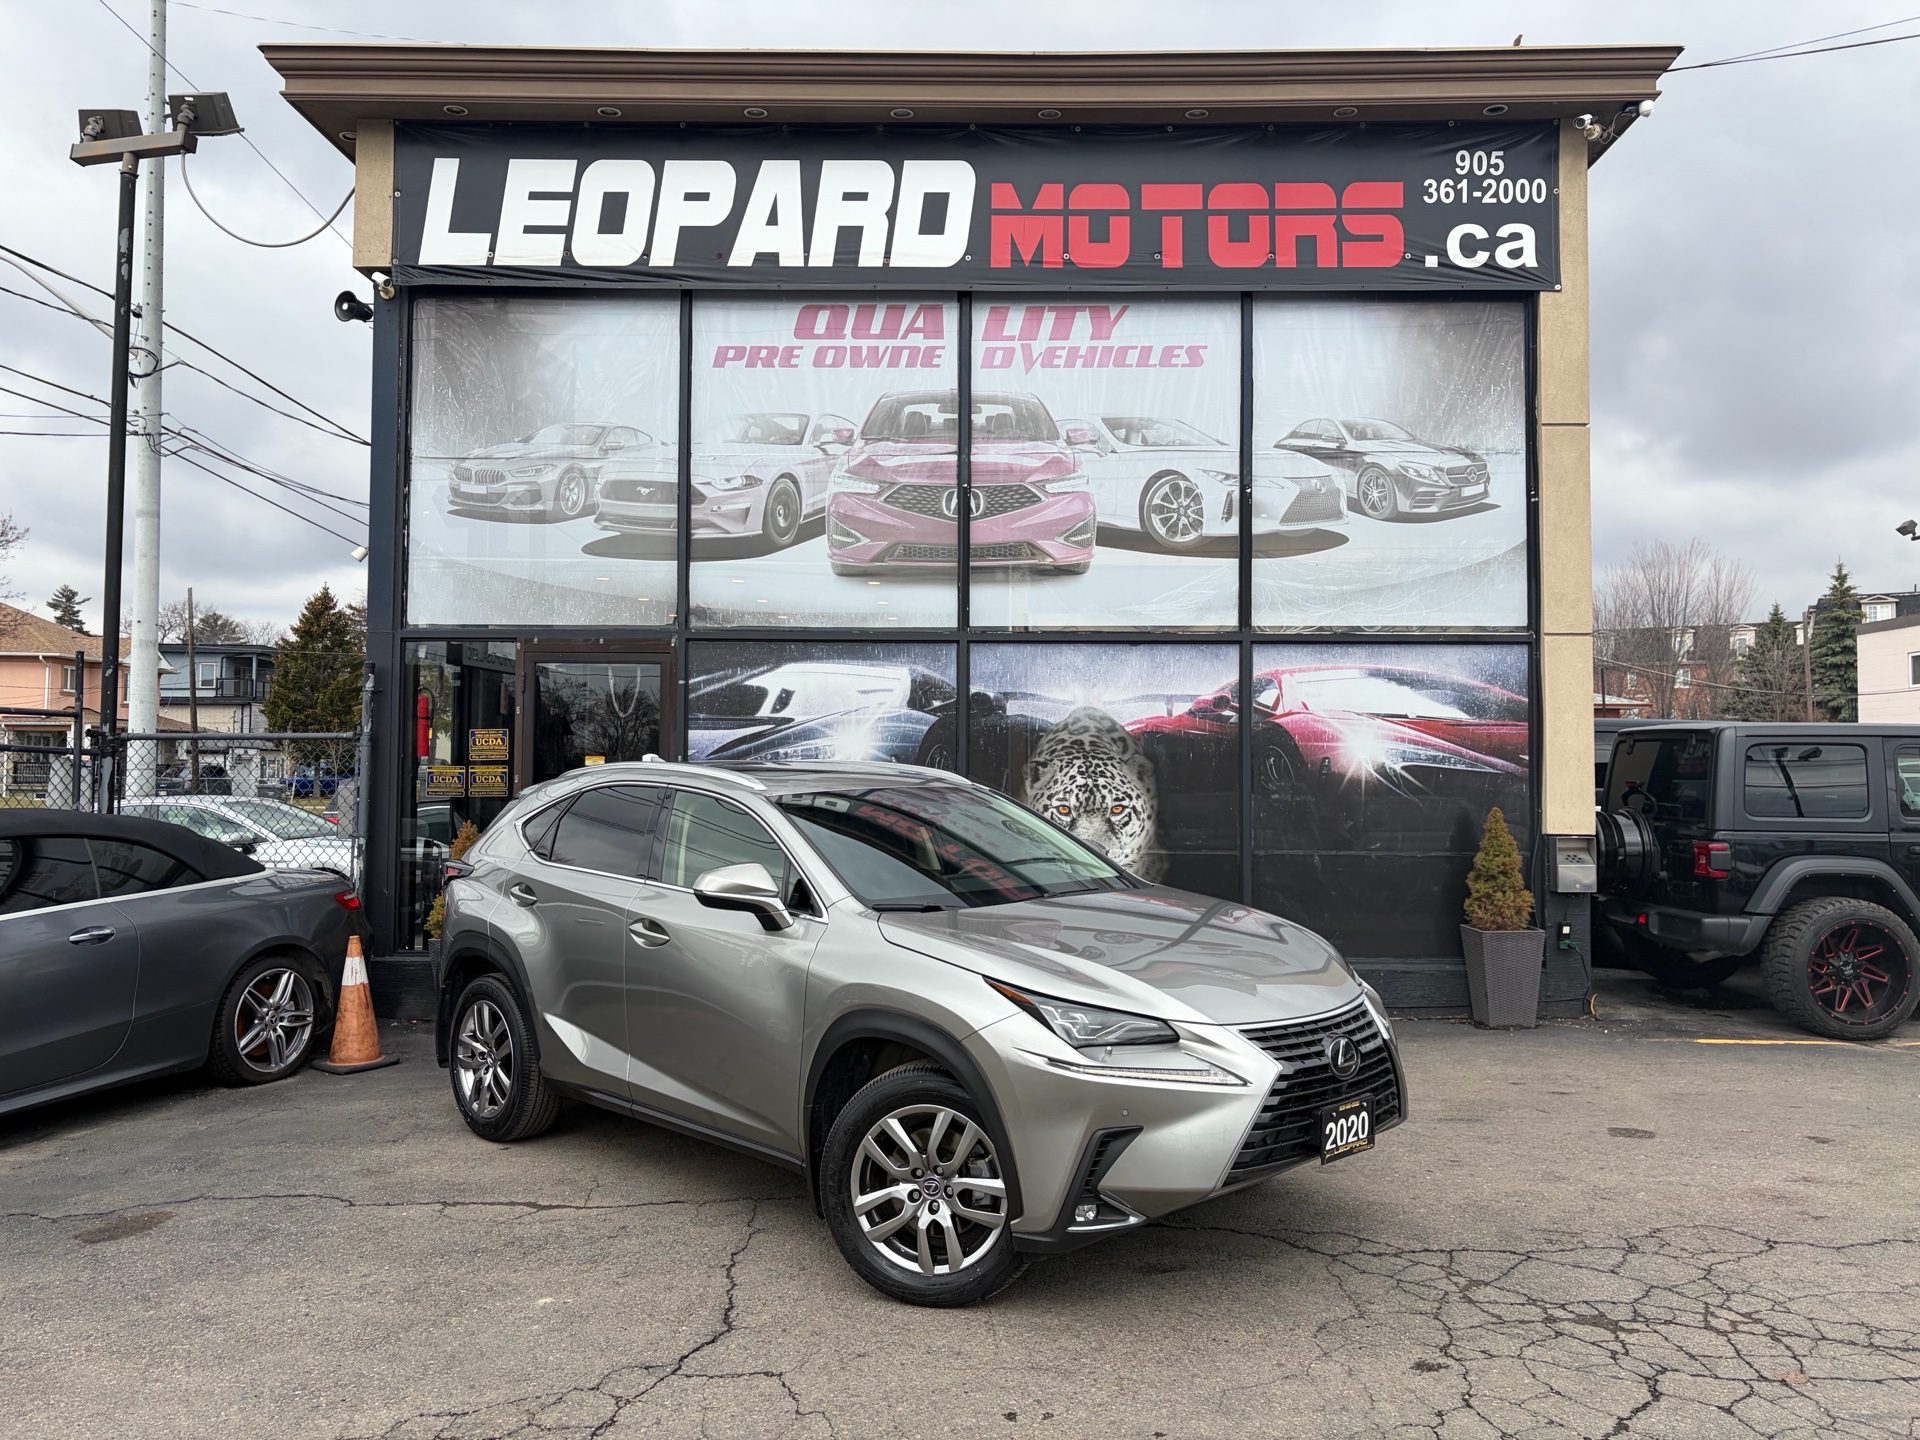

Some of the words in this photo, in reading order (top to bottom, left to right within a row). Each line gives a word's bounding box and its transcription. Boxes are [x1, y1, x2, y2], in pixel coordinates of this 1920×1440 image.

[1455, 150, 1505, 176] 905
[1422, 178, 1547, 204] 361-2000
[417, 157, 977, 268] LEOPARD
[990, 181, 1405, 268] MOTORS
[1425, 223, 1539, 269] .ca
[793, 304, 945, 340] QUA
[981, 305, 1130, 341] LITY
[712, 345, 804, 369] PRE
[812, 345, 946, 369] OWNE
[1325, 1110, 1369, 1151] 2020
